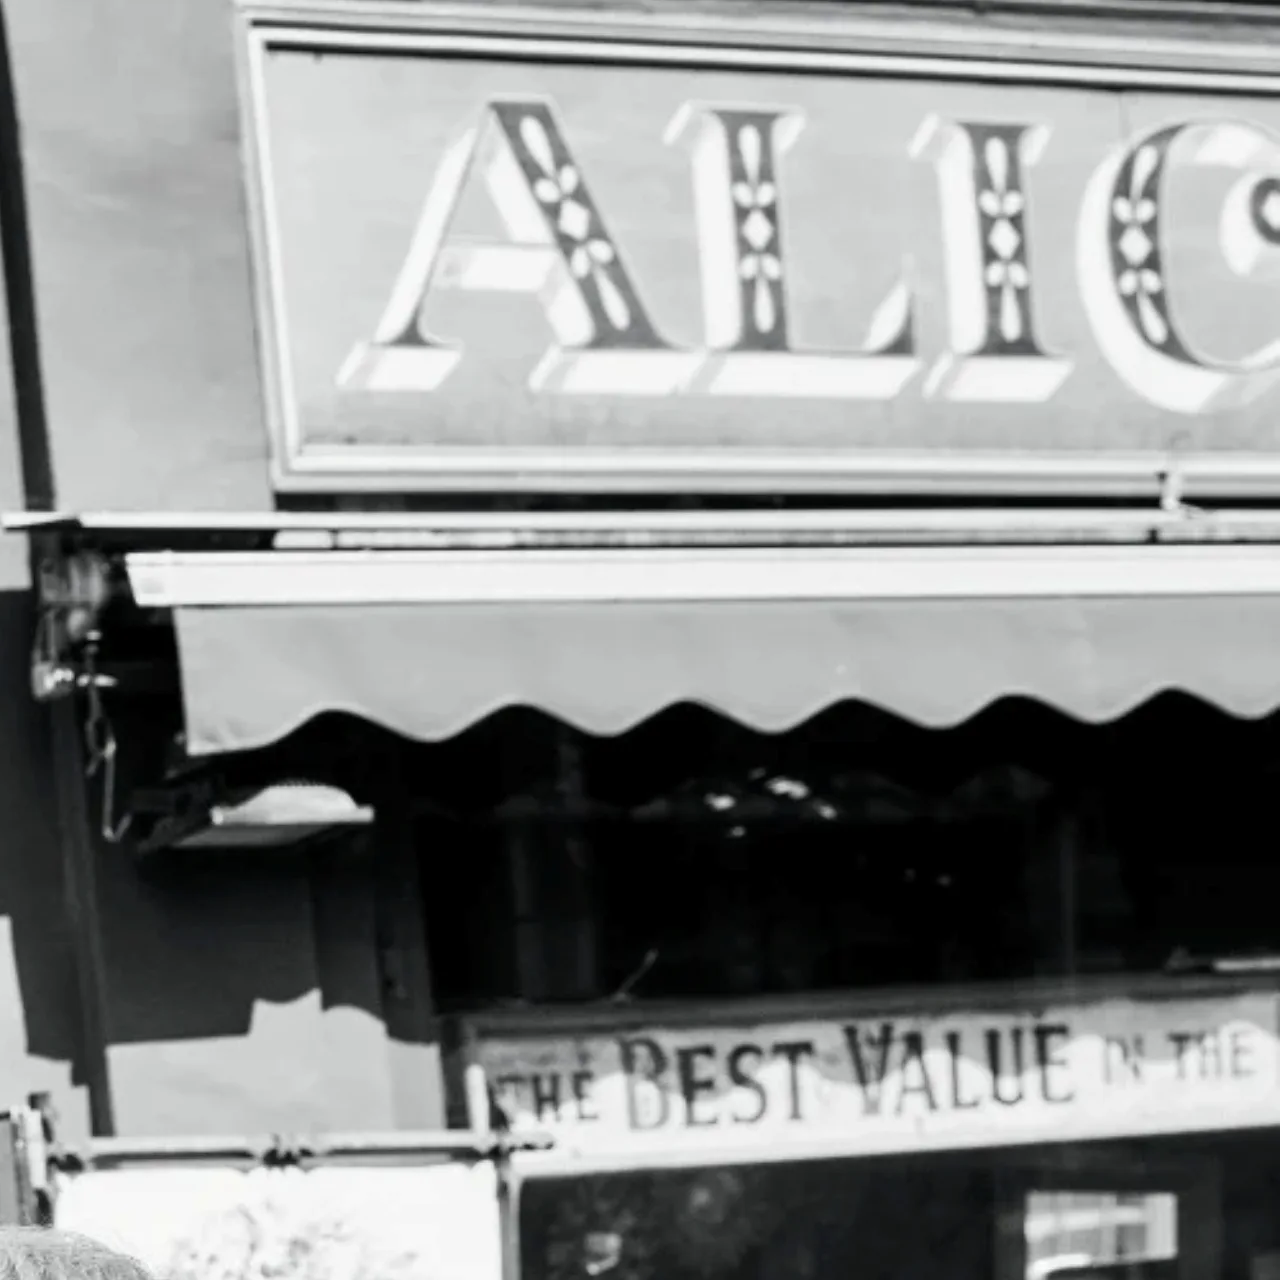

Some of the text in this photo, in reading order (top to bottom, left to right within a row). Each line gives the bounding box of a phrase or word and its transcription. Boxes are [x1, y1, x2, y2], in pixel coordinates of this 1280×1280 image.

[337, 95, 1280, 412] ALIC
[620, 1036, 814, 1131] BEST
[842, 1022, 1075, 1117] VALUE
[1166, 1029, 1259, 1081] THE
